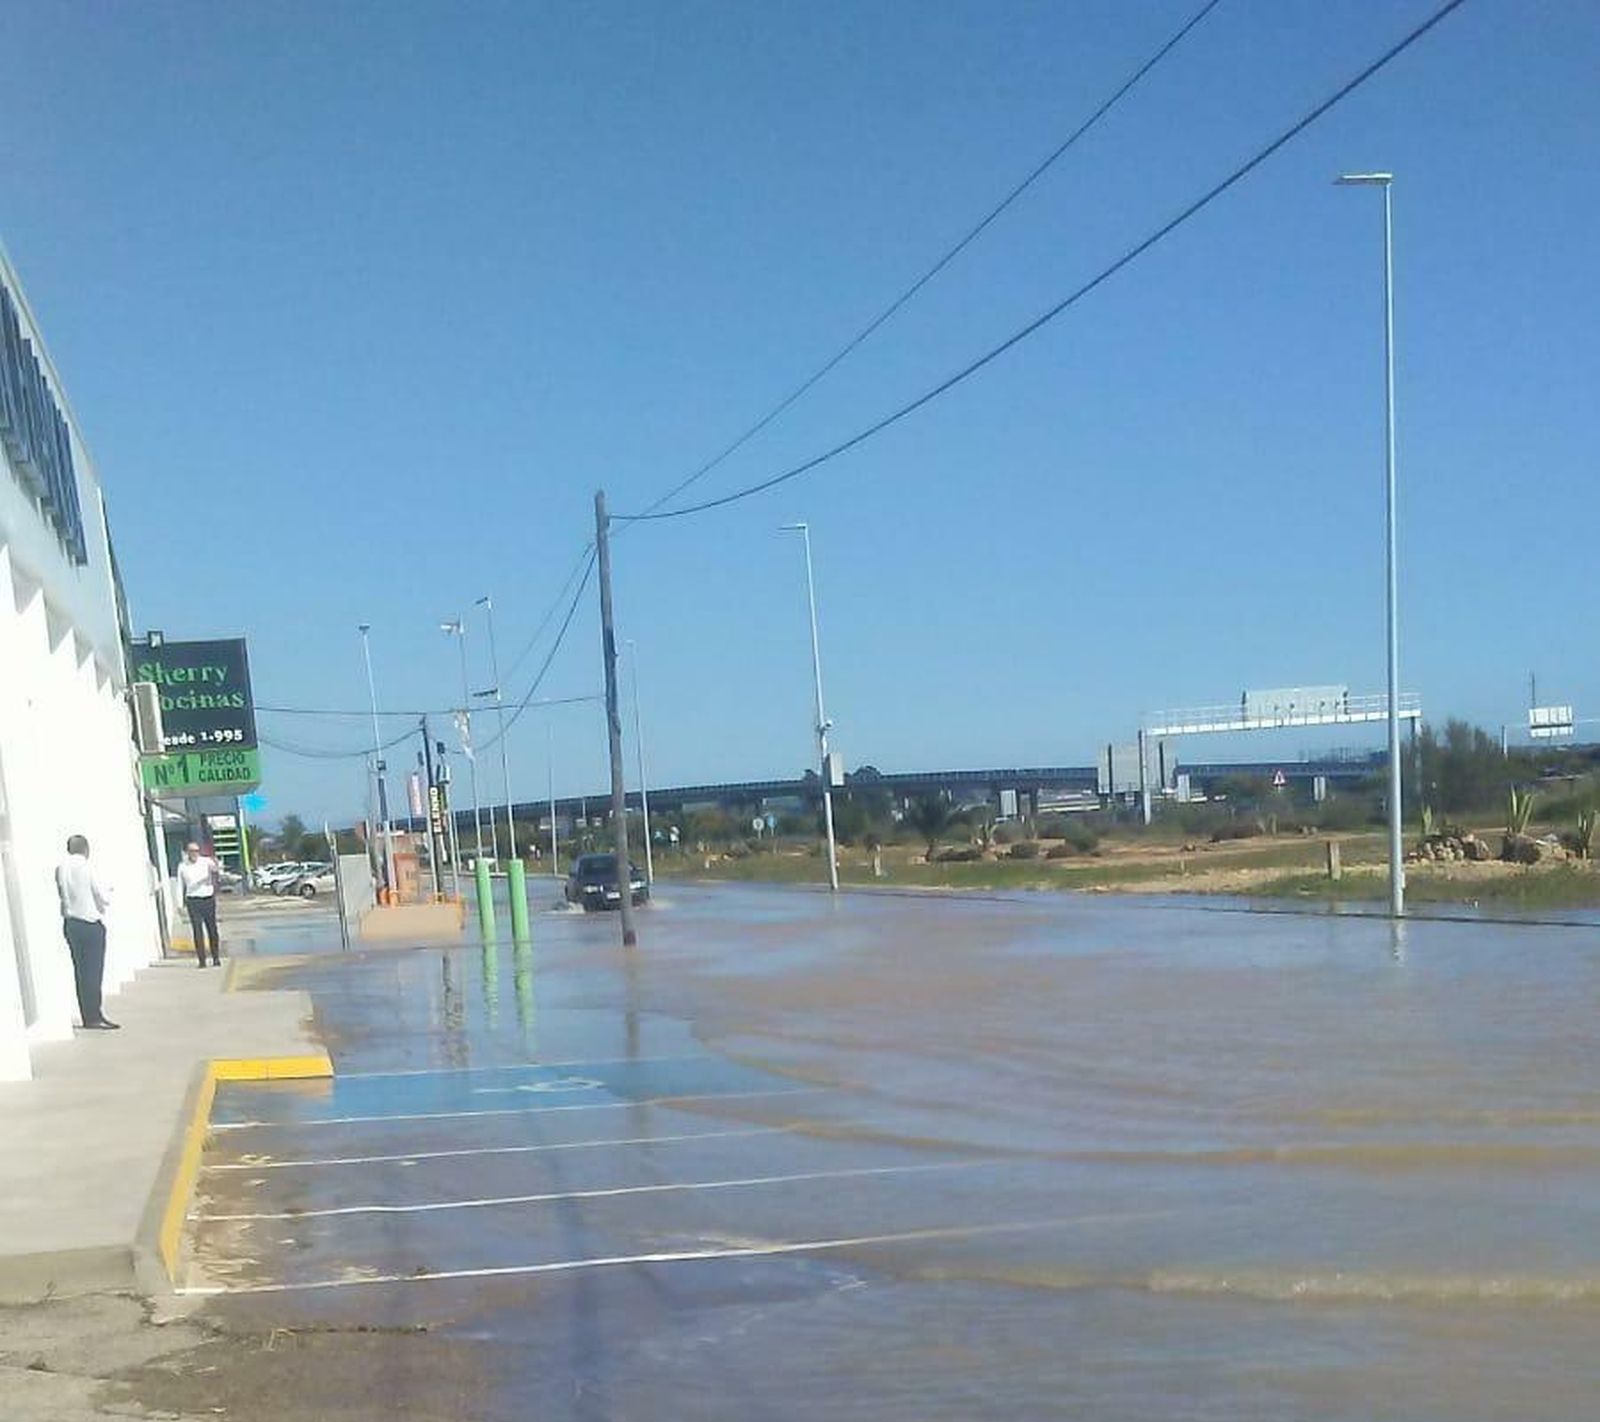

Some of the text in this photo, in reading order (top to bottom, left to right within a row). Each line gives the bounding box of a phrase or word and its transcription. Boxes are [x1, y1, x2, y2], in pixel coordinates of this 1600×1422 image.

[138, 662, 228, 686] Sherry
[160, 690, 245, 711] ocinas
[163, 729, 243, 746] esde 1.995
[201, 752, 245, 766] PRECIO
[199, 767, 250, 782] CALIDAD
